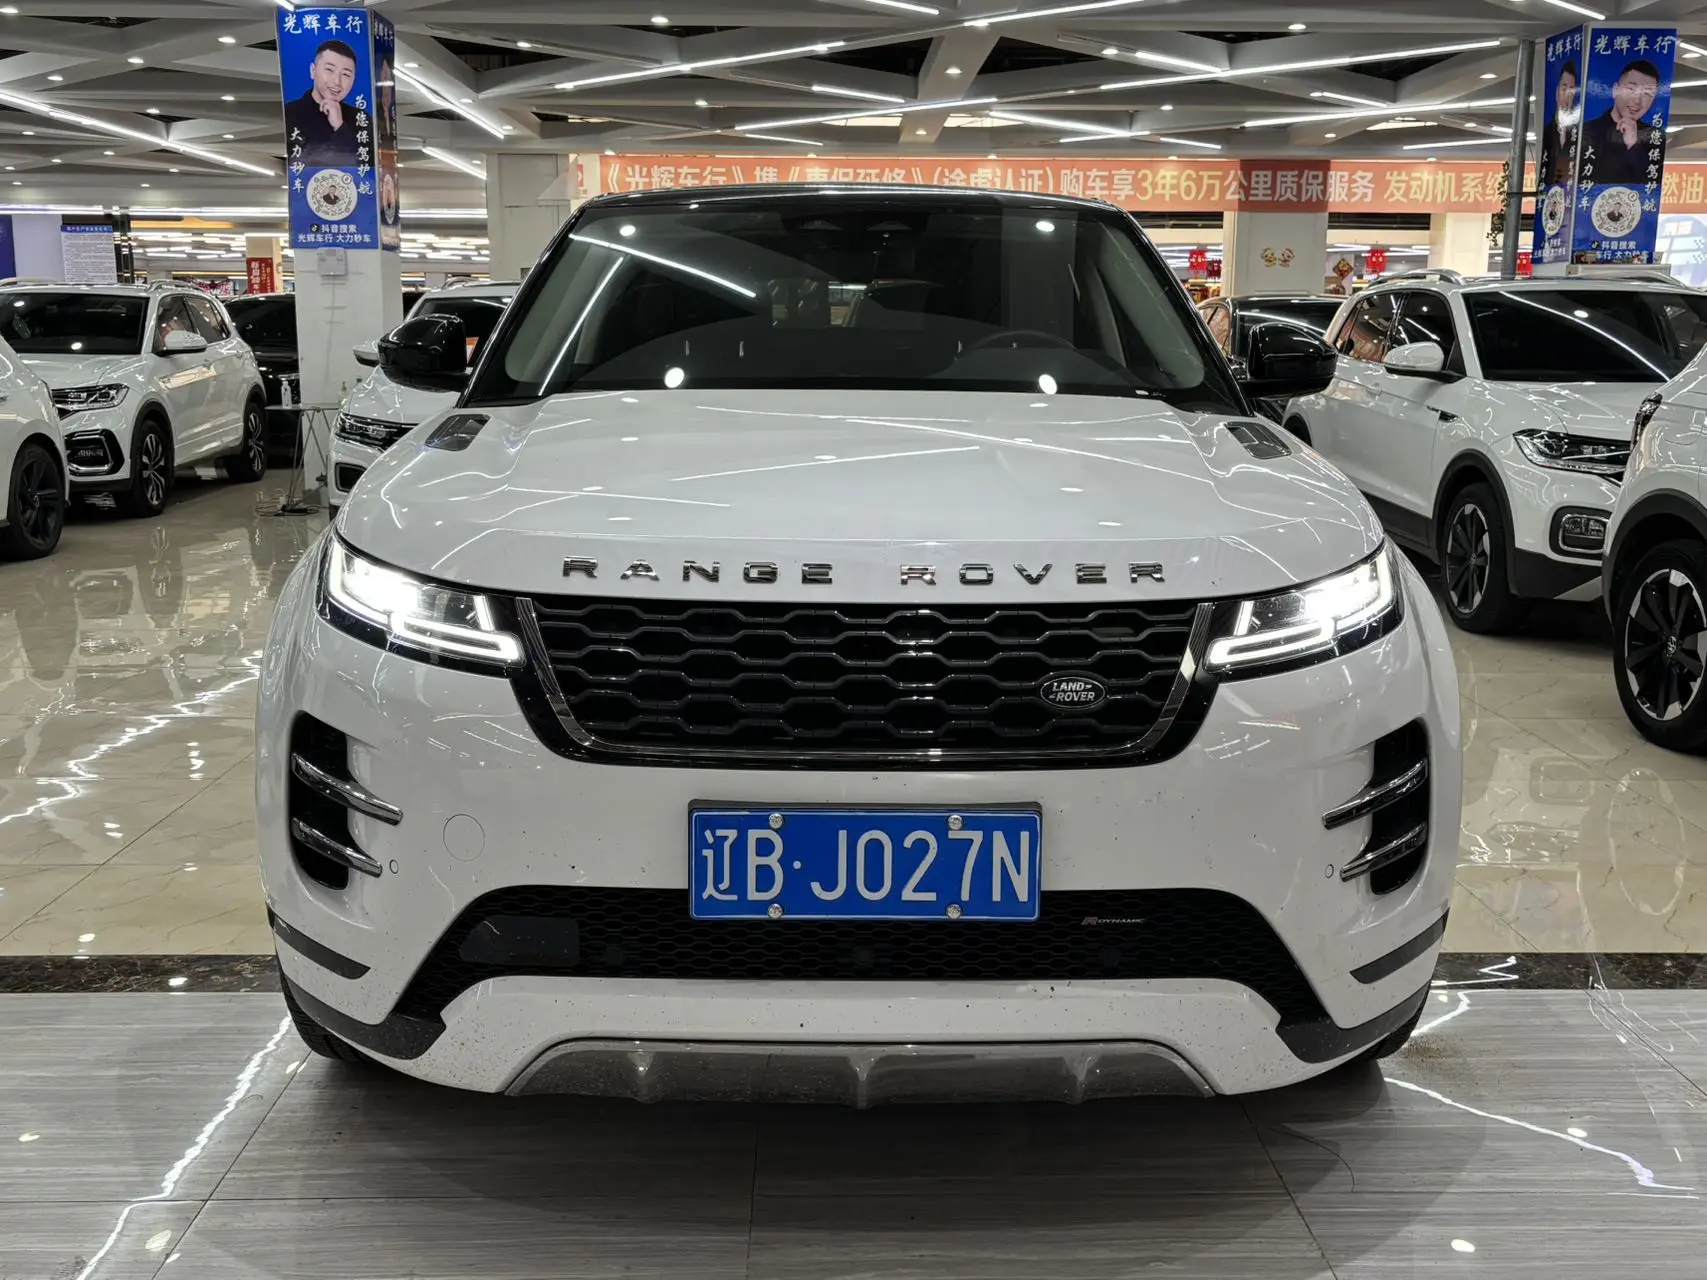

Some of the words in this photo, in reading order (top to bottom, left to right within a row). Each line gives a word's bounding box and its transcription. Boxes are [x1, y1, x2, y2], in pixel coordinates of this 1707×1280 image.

[283, 13, 363, 36] 光辉车行
[1594, 34, 1673, 56] 光辉车行
[354, 93, 373, 195] 为您保驾护航
[290, 126, 306, 194] 大力秒车
[1642, 111, 1664, 212] 为您保驾护航
[1579, 145, 1596, 212] 大力秒车
[298, 233, 333, 243] 光辉车行
[321, 224, 357, 233] 抖音搜索
[562, 556, 834, 585] RANGE
[900, 562, 1166, 586] ROVER
